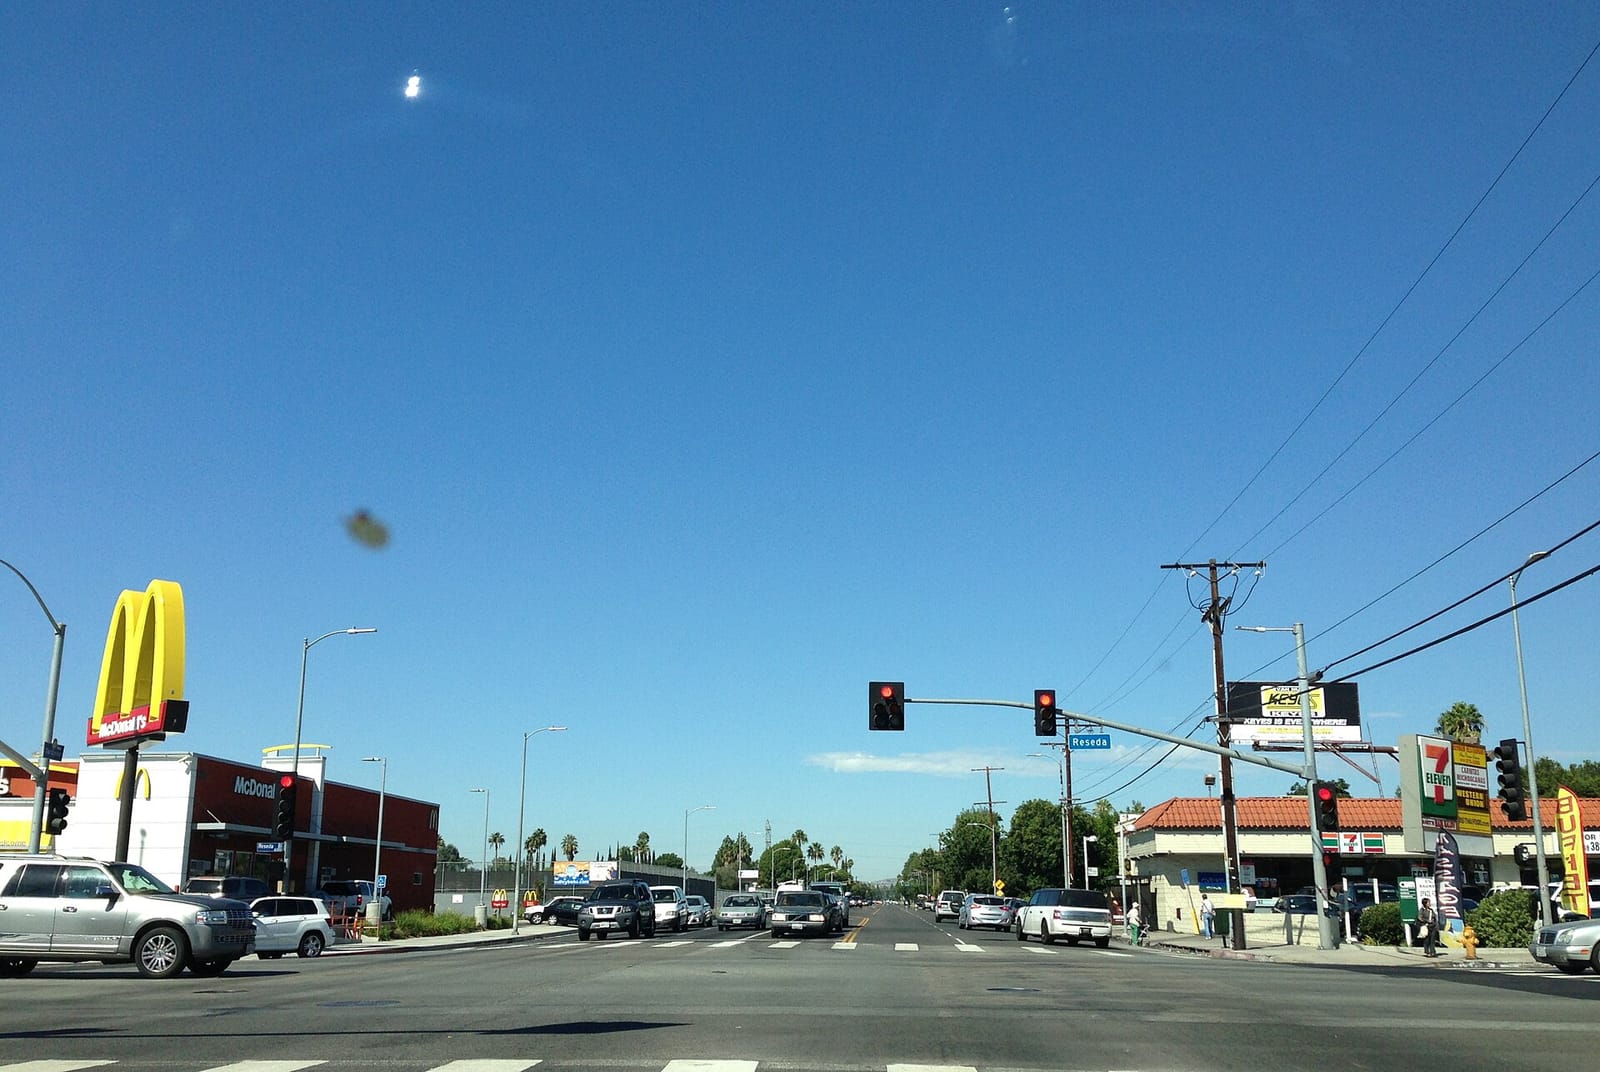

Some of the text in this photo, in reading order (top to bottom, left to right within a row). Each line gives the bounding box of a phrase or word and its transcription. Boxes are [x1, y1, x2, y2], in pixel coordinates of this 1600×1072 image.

[1072, 737, 1107, 746] Reseda
[1425, 744, 1449, 804] 7
[234, 775, 276, 799] McDonal
[1456, 789, 1484, 800] WESTERN
